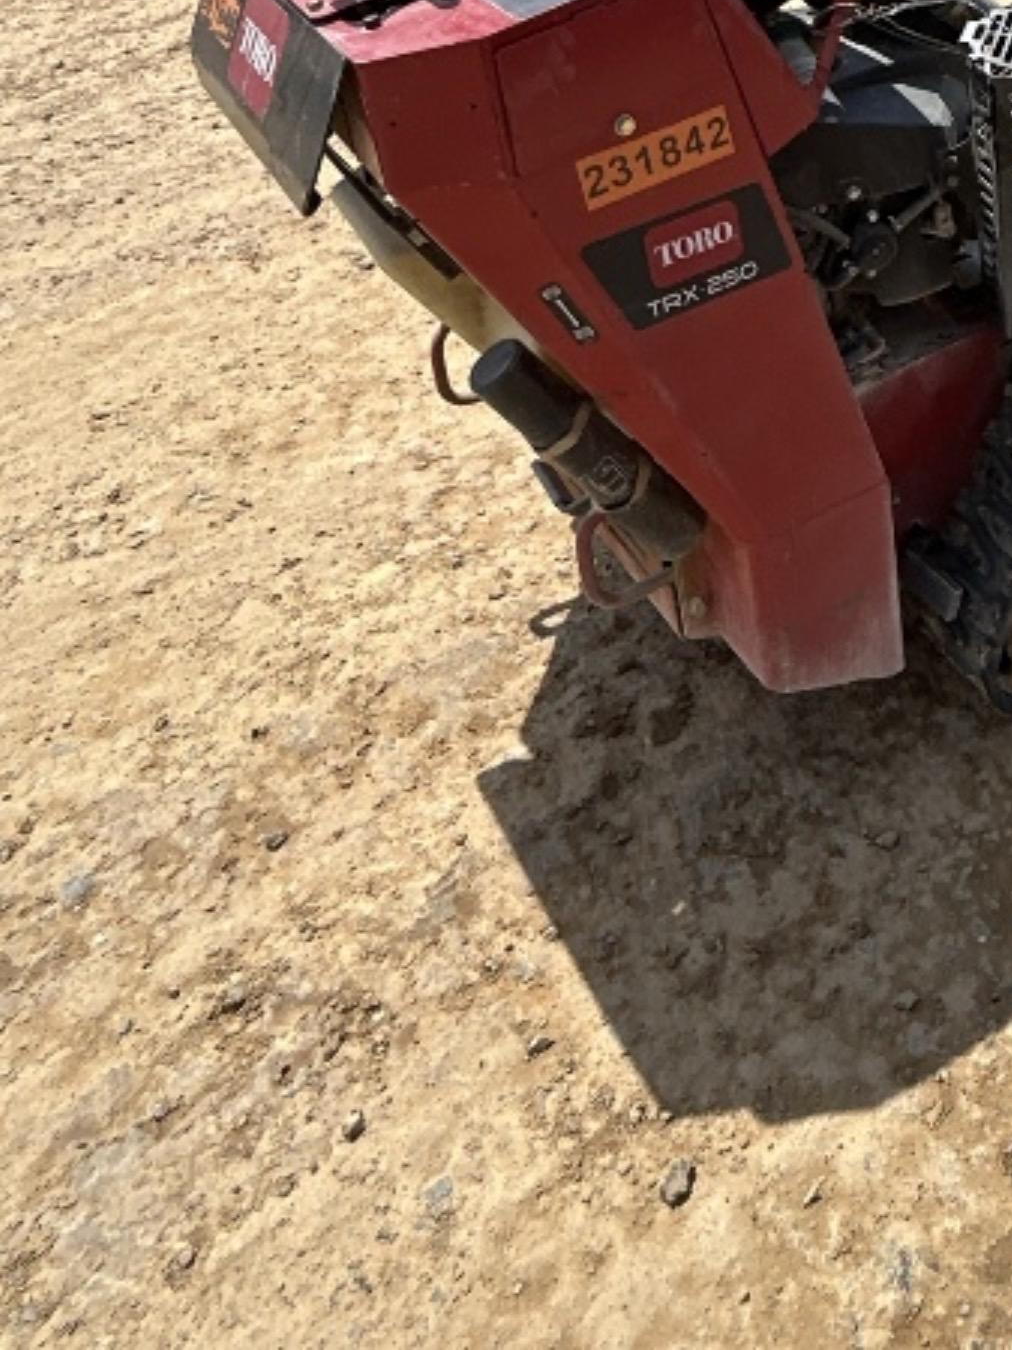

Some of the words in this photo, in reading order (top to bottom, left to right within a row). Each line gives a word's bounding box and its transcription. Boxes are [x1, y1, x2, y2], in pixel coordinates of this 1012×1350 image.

[240, 17, 277, 87] TORO
[585, 117, 729, 199] 231842
[654, 221, 734, 267] TORO
[648, 260, 759, 317] TRX-250
